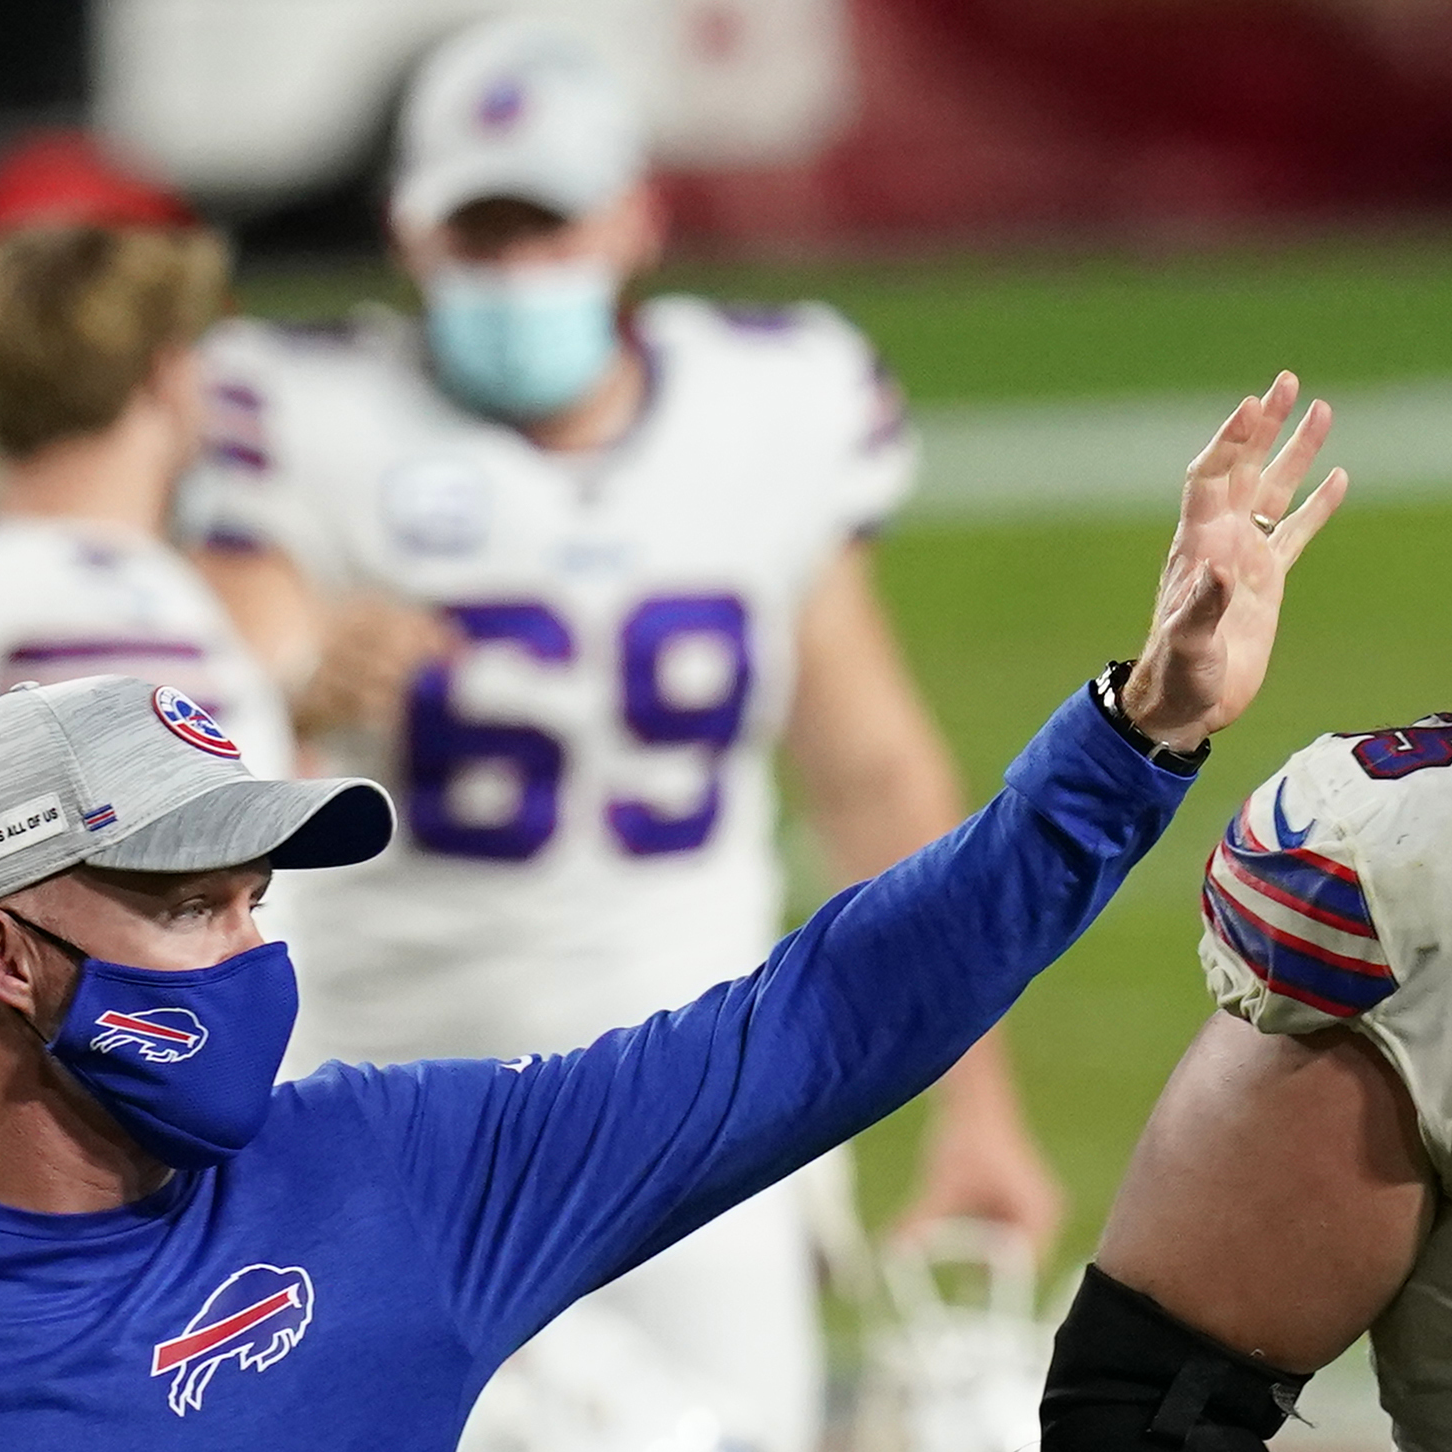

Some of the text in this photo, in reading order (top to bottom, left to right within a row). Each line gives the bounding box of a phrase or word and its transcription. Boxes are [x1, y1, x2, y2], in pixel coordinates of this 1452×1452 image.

[404, 591, 753, 863] 69
[7, 822, 27, 838] ALL
[27, 814, 41, 829] OF
[42, 807, 59, 822] US
